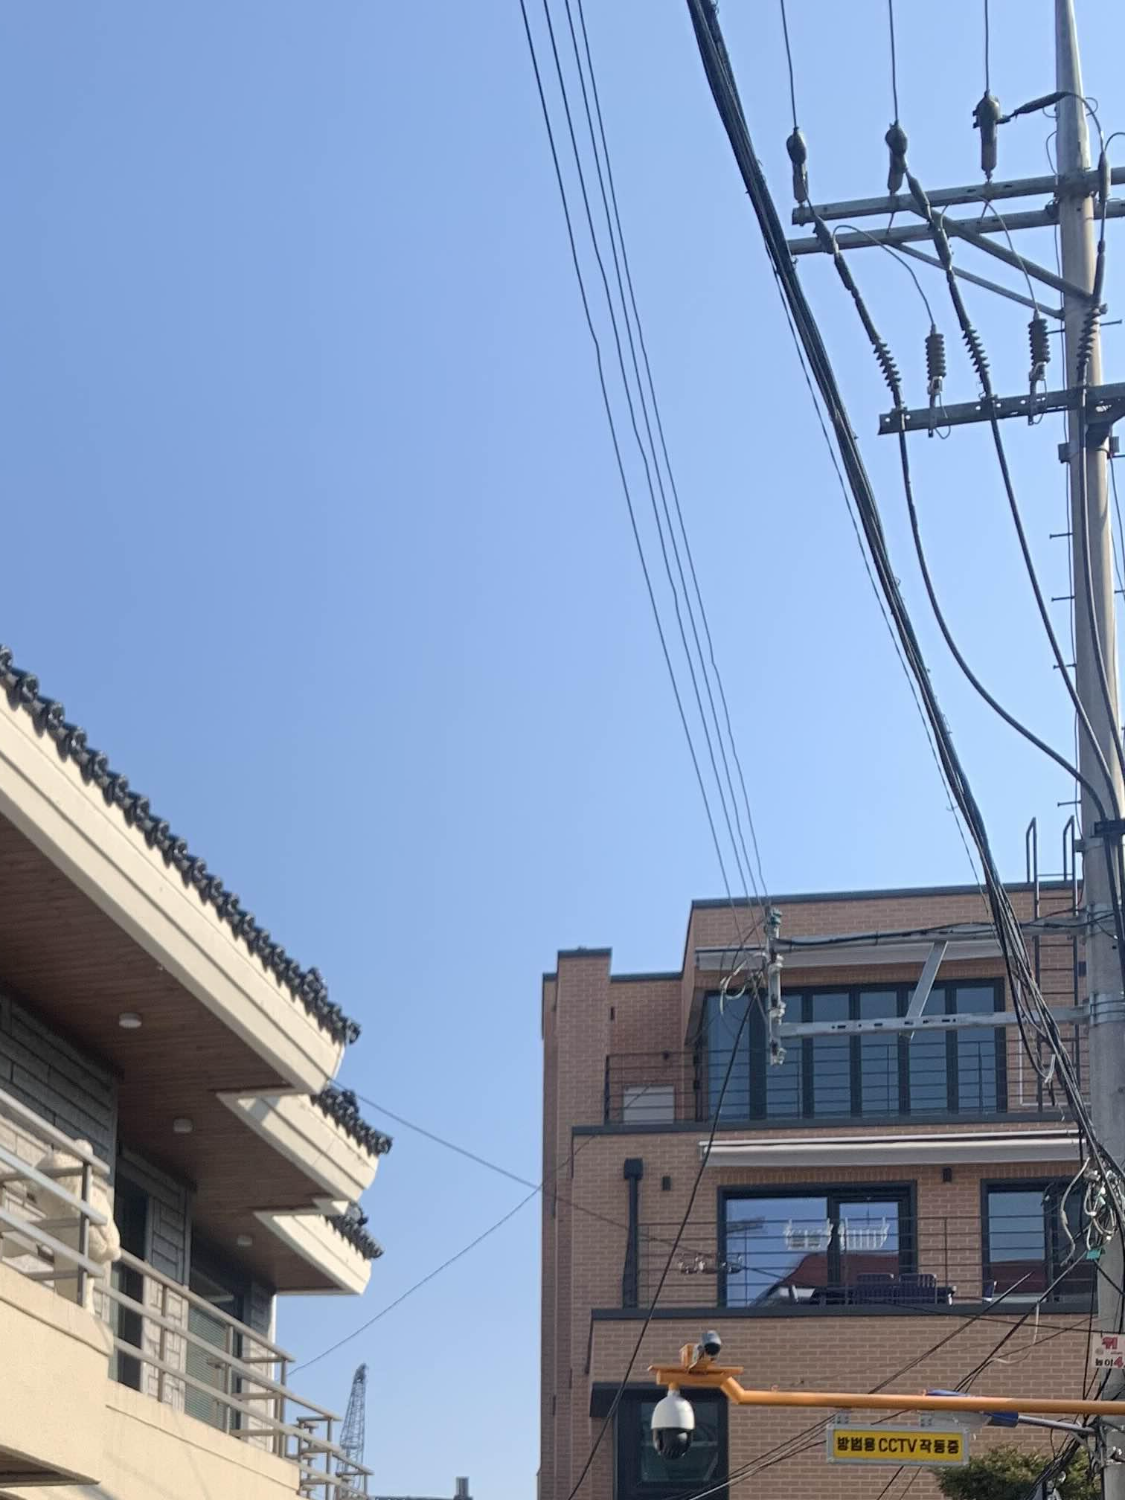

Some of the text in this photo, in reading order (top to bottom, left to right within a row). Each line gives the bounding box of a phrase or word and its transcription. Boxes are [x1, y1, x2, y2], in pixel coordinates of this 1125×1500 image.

[837, 1436, 959, 1454] 방범용 CCTV 작동중
